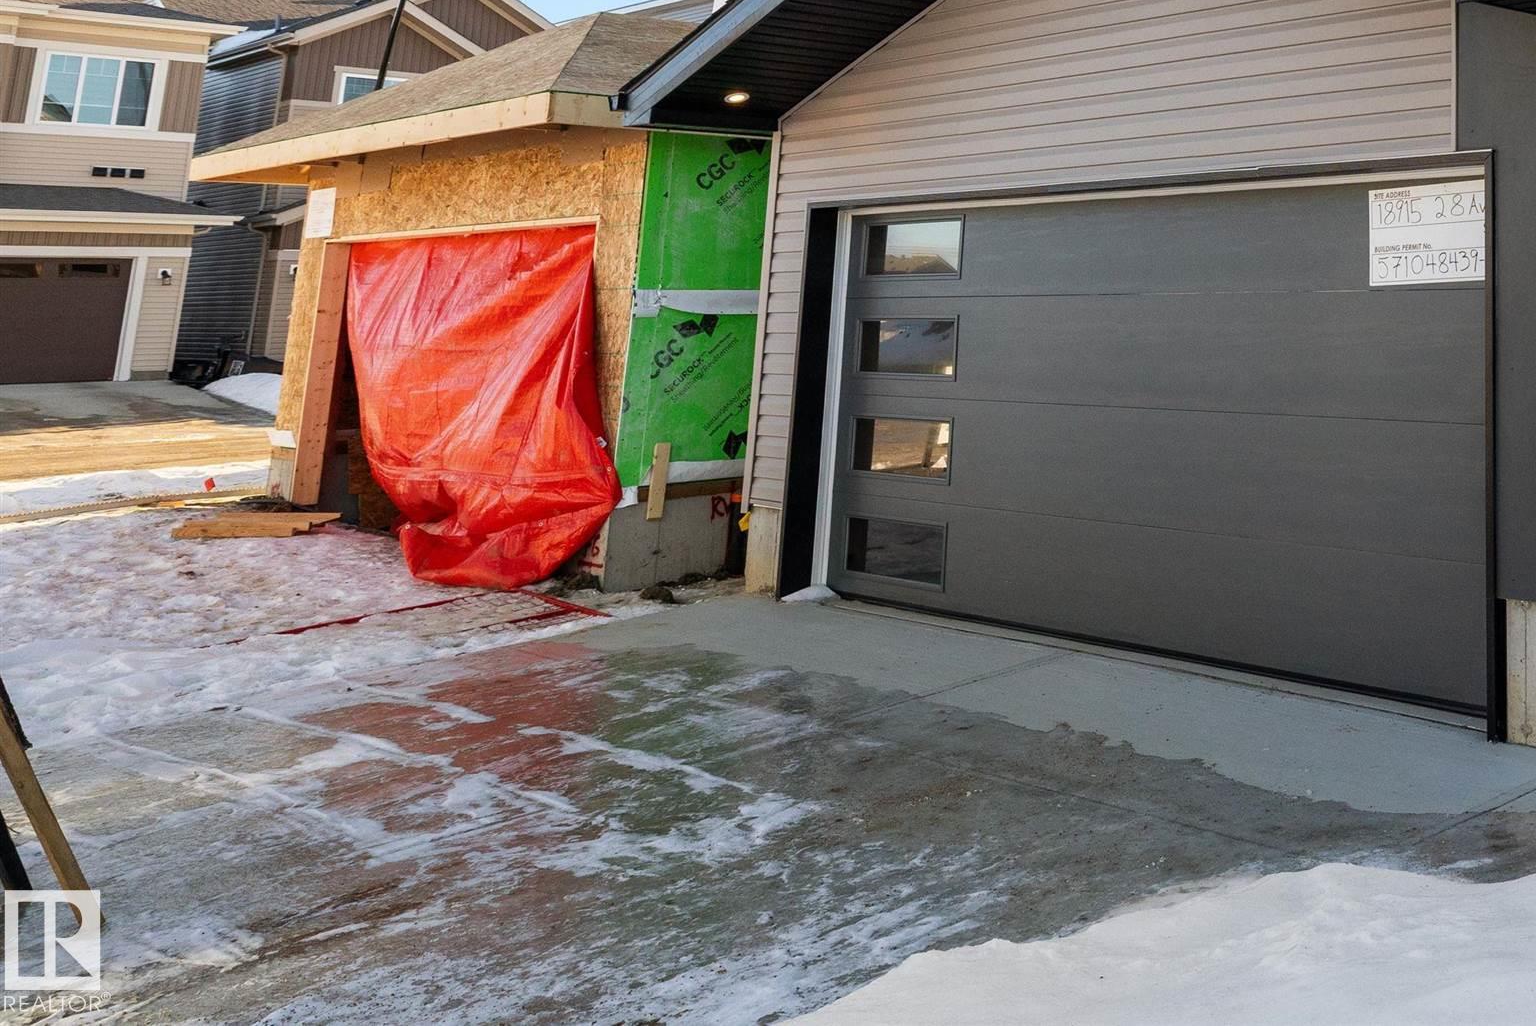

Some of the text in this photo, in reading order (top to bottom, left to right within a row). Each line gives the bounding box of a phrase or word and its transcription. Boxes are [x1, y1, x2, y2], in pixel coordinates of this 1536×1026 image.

[696, 153, 736, 190] CGC
[716, 172, 754, 206] SECUROCK
[1374, 190, 1411, 200] SITE ADDRESS
[1378, 198, 1422, 226] 18915
[1434, 194, 1465, 219] 28
[1374, 245, 1401, 253] BUILDING
[1402, 243, 1422, 251] PERMIT
[664, 356, 704, 395] SECUROCK
